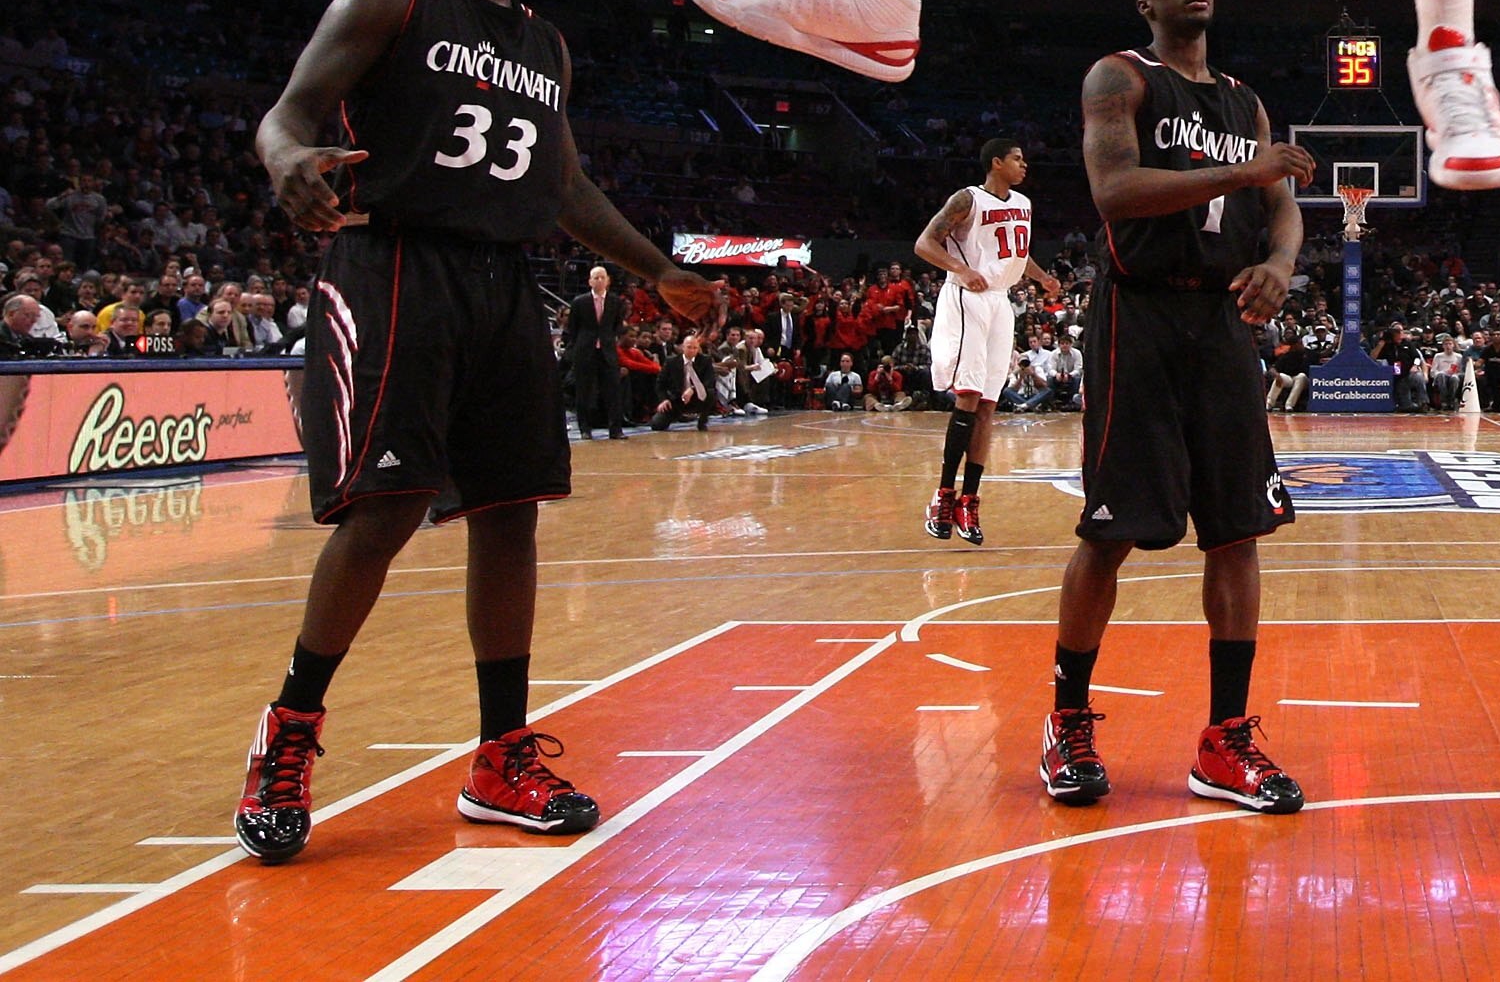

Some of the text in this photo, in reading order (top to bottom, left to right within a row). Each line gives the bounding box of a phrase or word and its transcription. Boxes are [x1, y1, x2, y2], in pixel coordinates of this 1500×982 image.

[426, 39, 561, 113] CINCINNATI
[1338, 57, 1373, 85] 35
[433, 102, 539, 182] 33
[1154, 110, 1259, 165] CINCINNAT
[679, 237, 785, 265] Budweiser
[994, 224, 1029, 260] 10
[1312, 377, 1389, 388] PriceGrabber.com
[1312, 390, 1389, 401] PriceGrabber.com
[70, 383, 214, 475] Reese's
